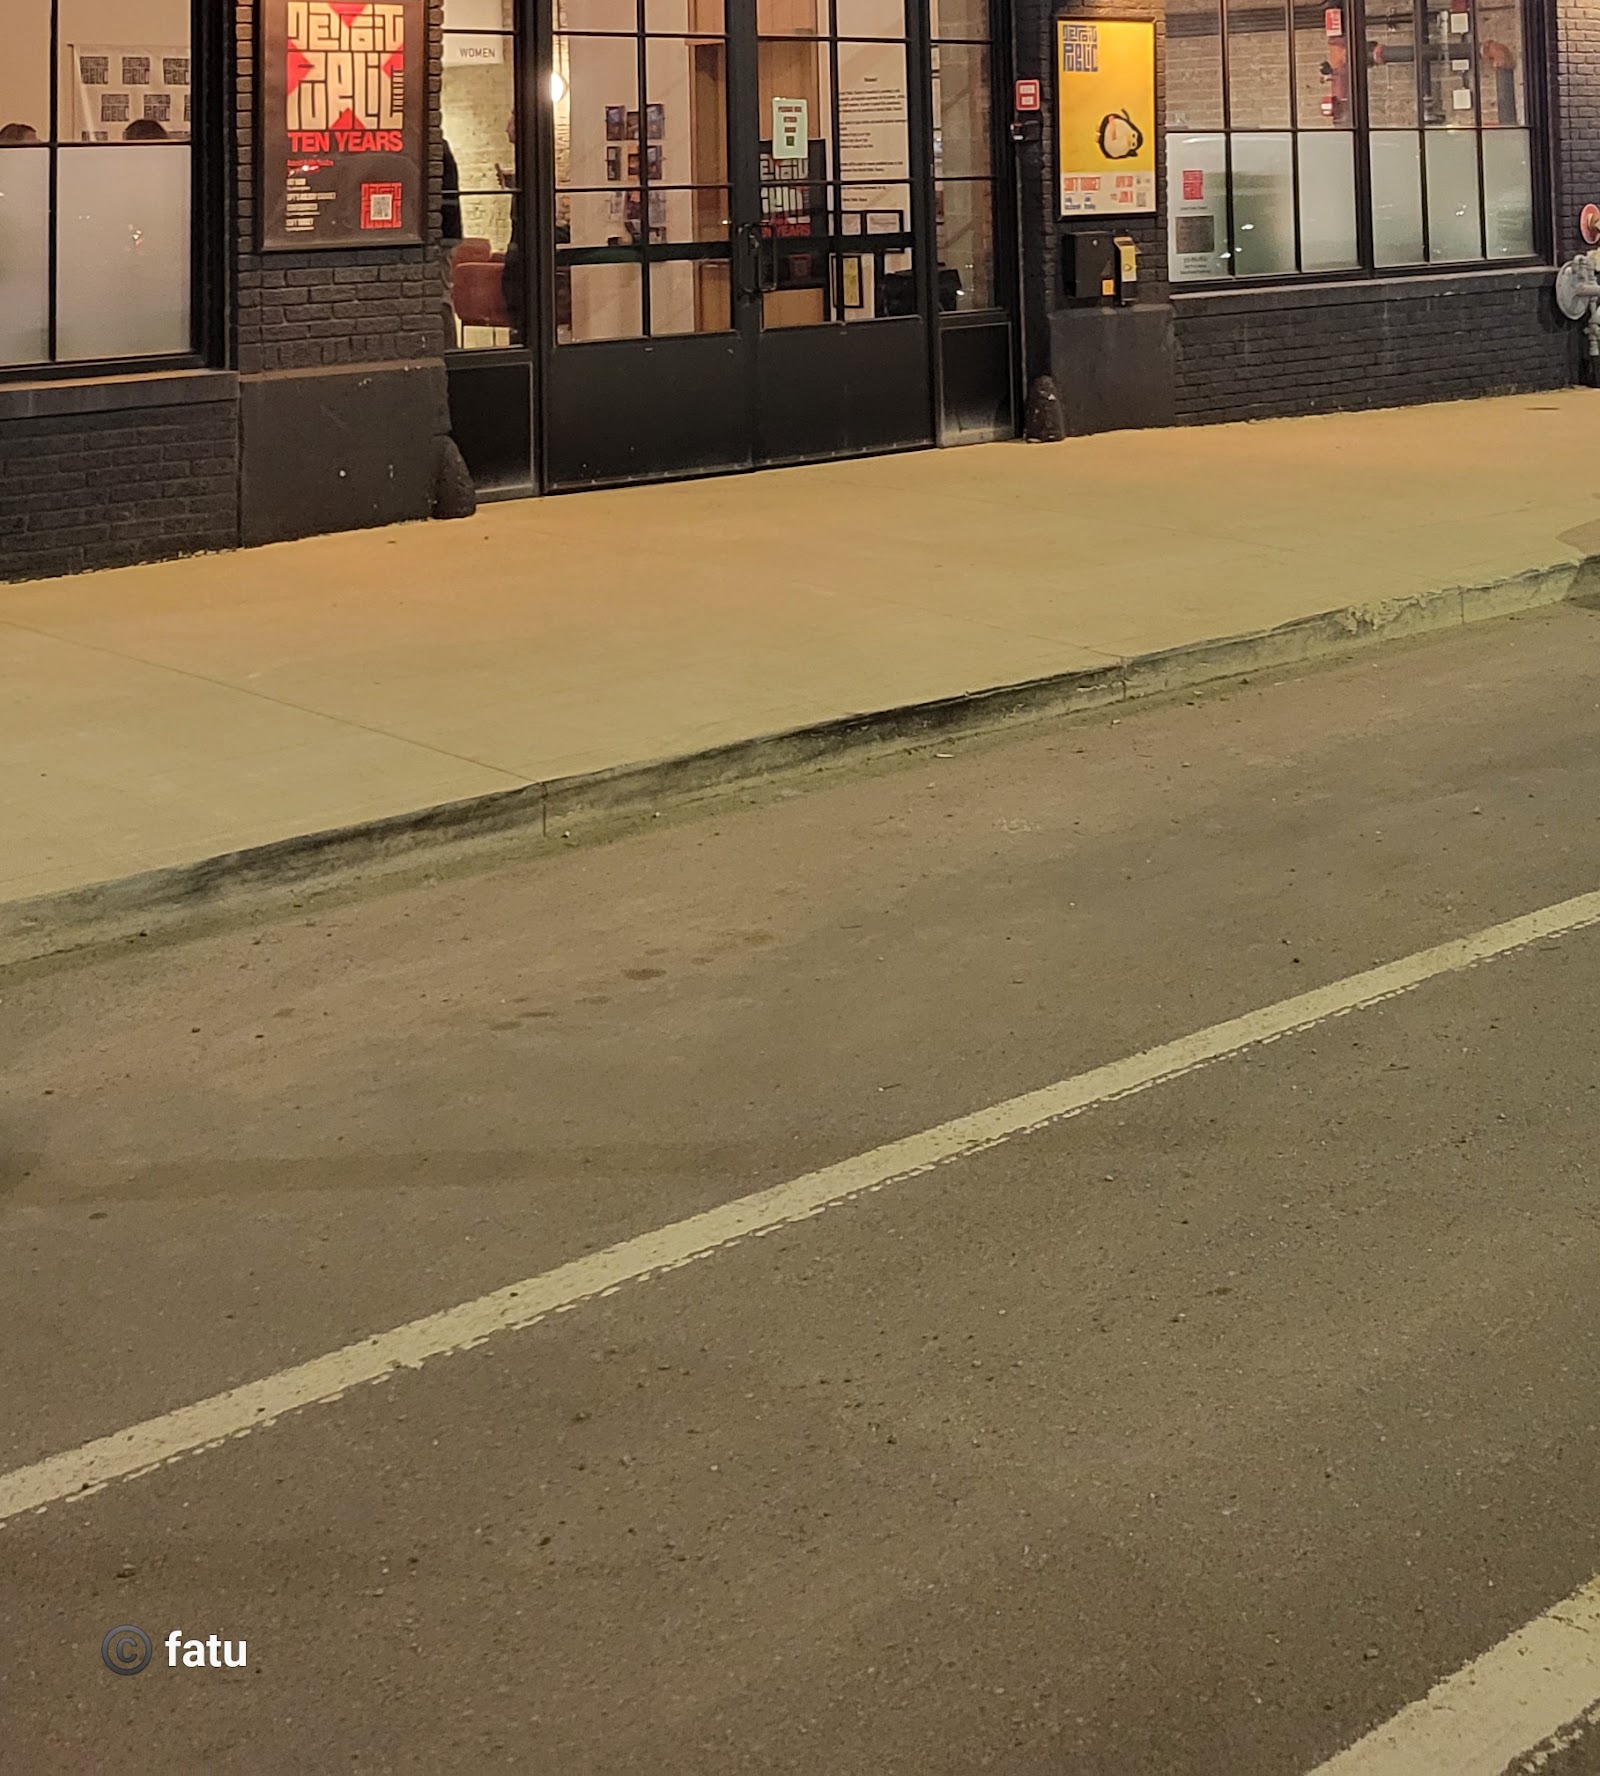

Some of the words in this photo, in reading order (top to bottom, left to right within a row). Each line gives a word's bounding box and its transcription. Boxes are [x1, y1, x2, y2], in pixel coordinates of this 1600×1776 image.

[459, 47, 496, 58] WOMEN
[287, 131, 330, 153] TEN
[334, 130, 404, 153] YEARS
[776, 224, 811, 237] YEARS
